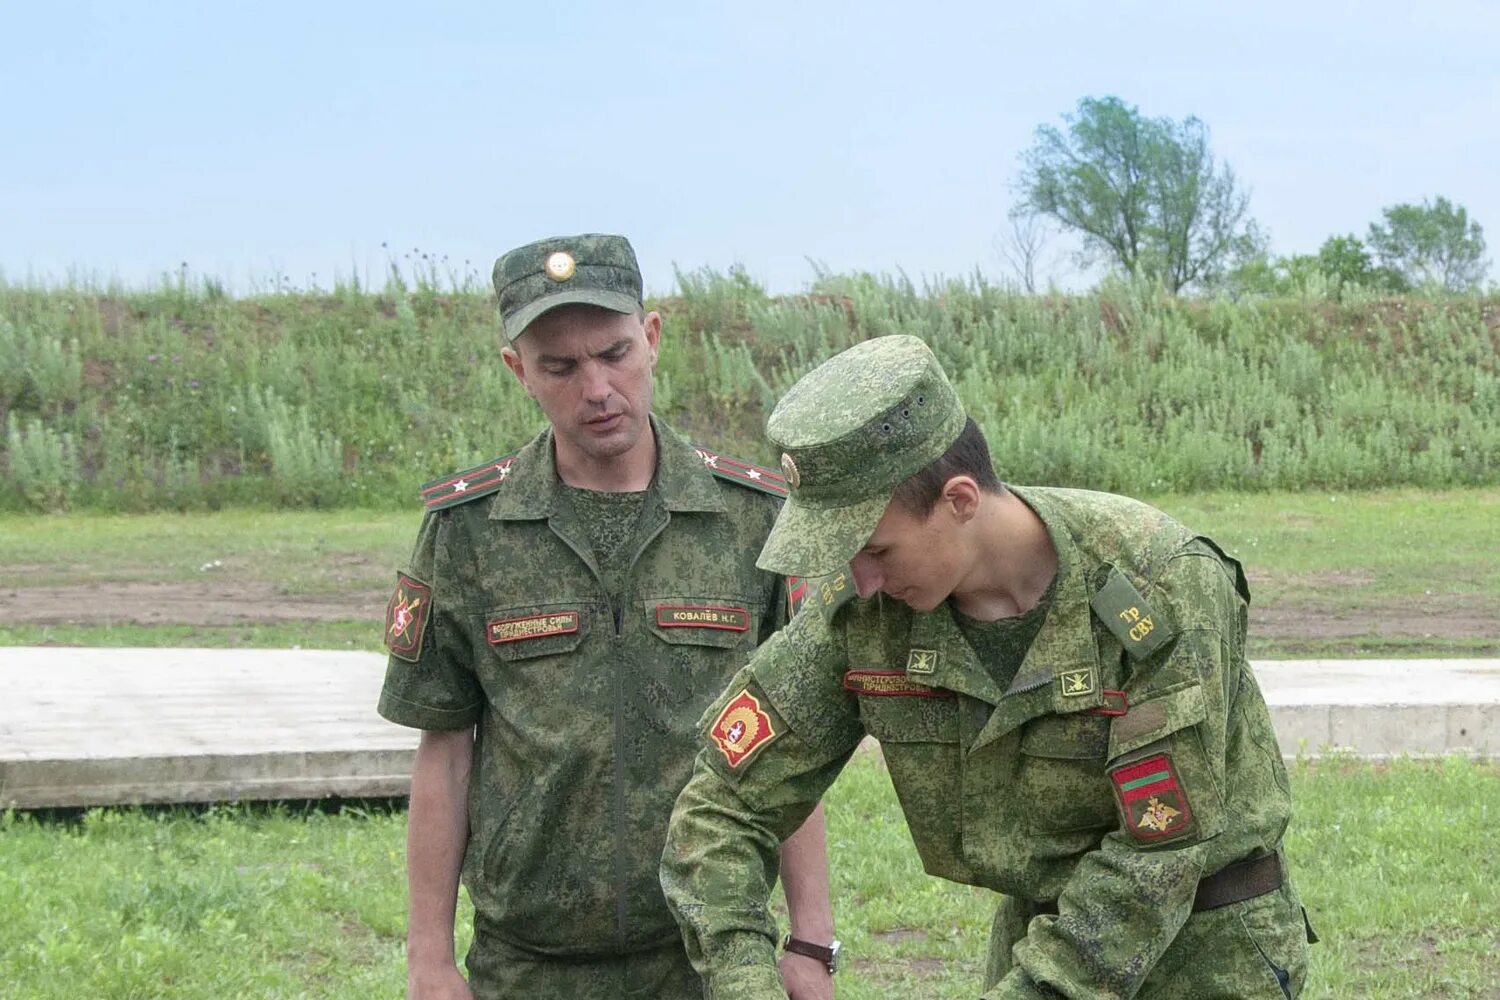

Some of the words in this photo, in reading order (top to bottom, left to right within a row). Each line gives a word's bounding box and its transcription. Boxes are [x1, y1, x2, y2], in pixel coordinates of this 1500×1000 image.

[673, 609, 718, 622] КОВАЛЁВ
[721, 614, 737, 624] Н.Г.
[1119, 606, 1140, 623] Тр
[493, 618, 547, 634] ВООРУЖЕННЫЕ
[549, 615, 573, 625] СИЛЫ
[1129, 614, 1154, 641] СВУ
